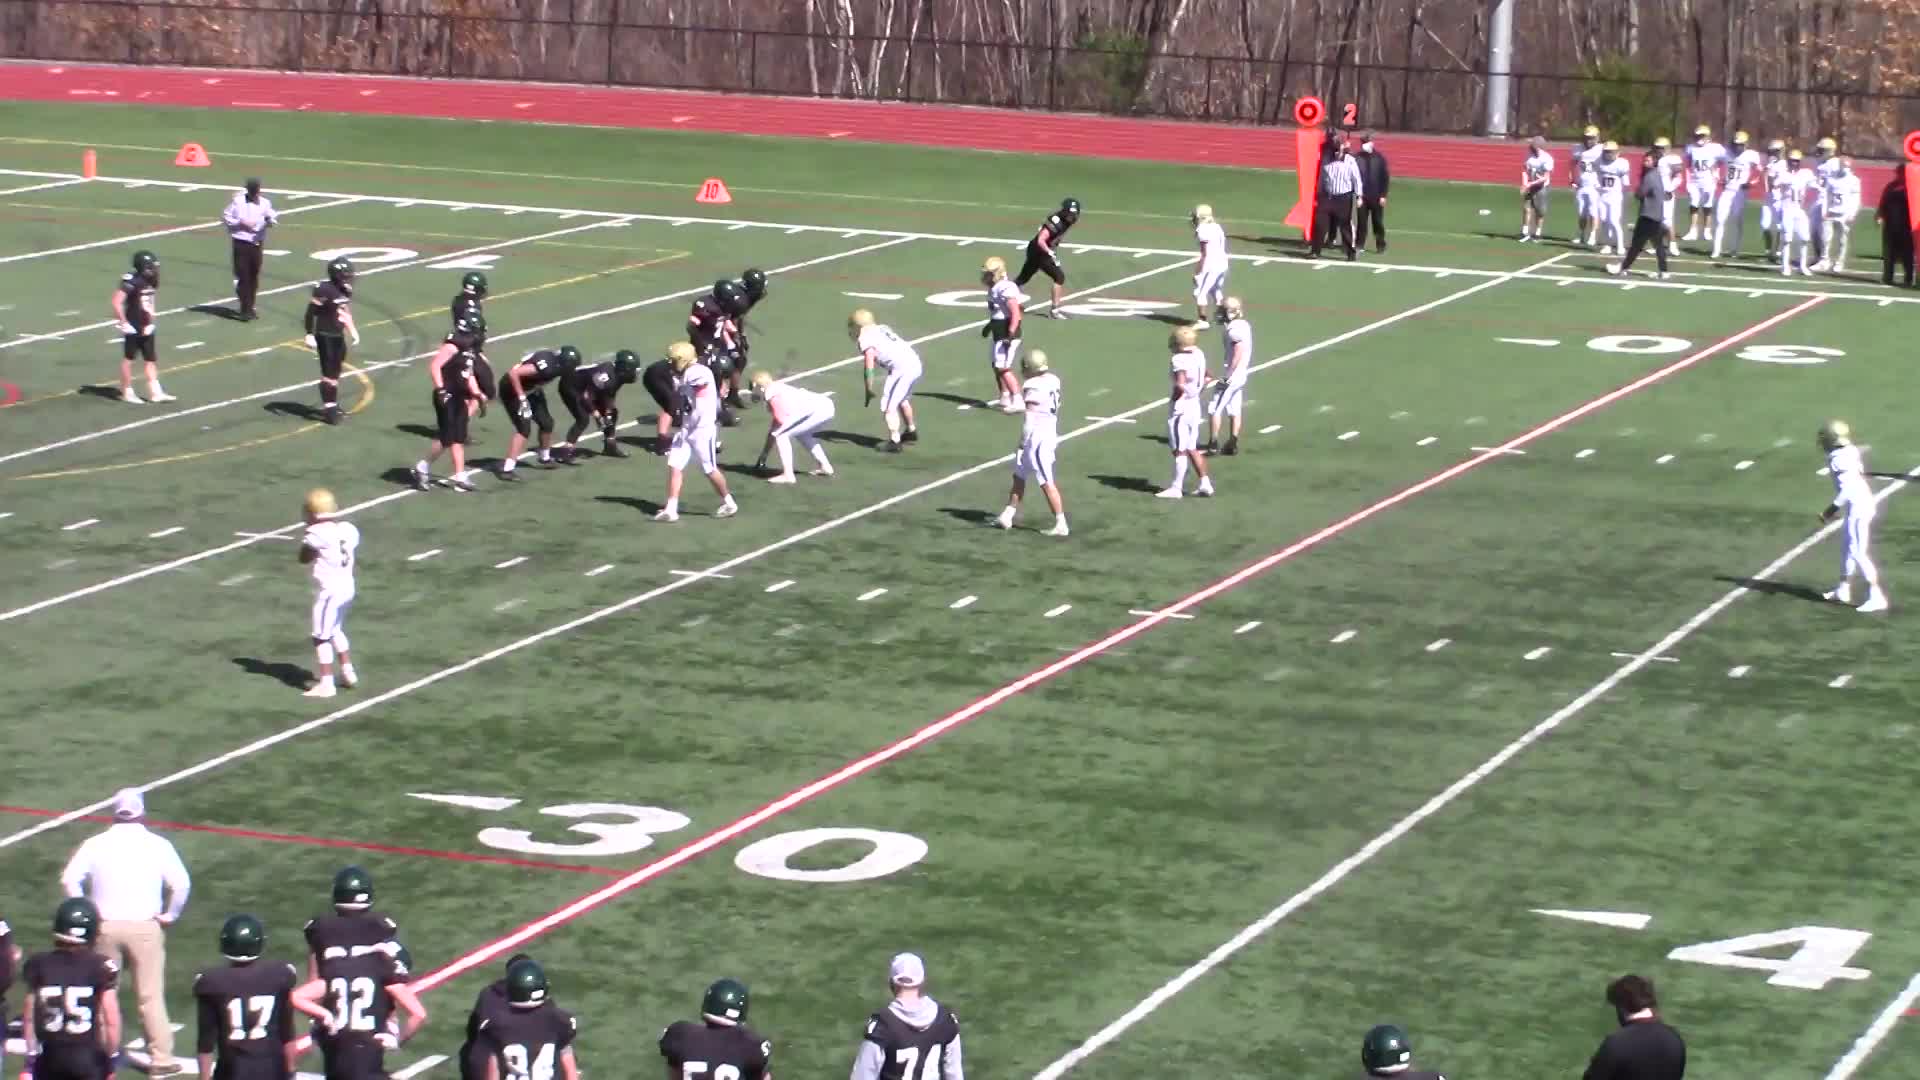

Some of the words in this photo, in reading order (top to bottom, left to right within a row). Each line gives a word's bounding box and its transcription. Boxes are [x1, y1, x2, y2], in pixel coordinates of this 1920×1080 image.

[1343, 103, 1357, 126] 2
[706, 183, 719, 200] 10
[1586, 335, 1846, 364] 30
[477, 803, 928, 882] 30
[39, 986, 94, 1034] 55
[226, 995, 276, 1041] 17
[329, 976, 376, 1031] 32
[896, 1043, 942, 1080] 74
